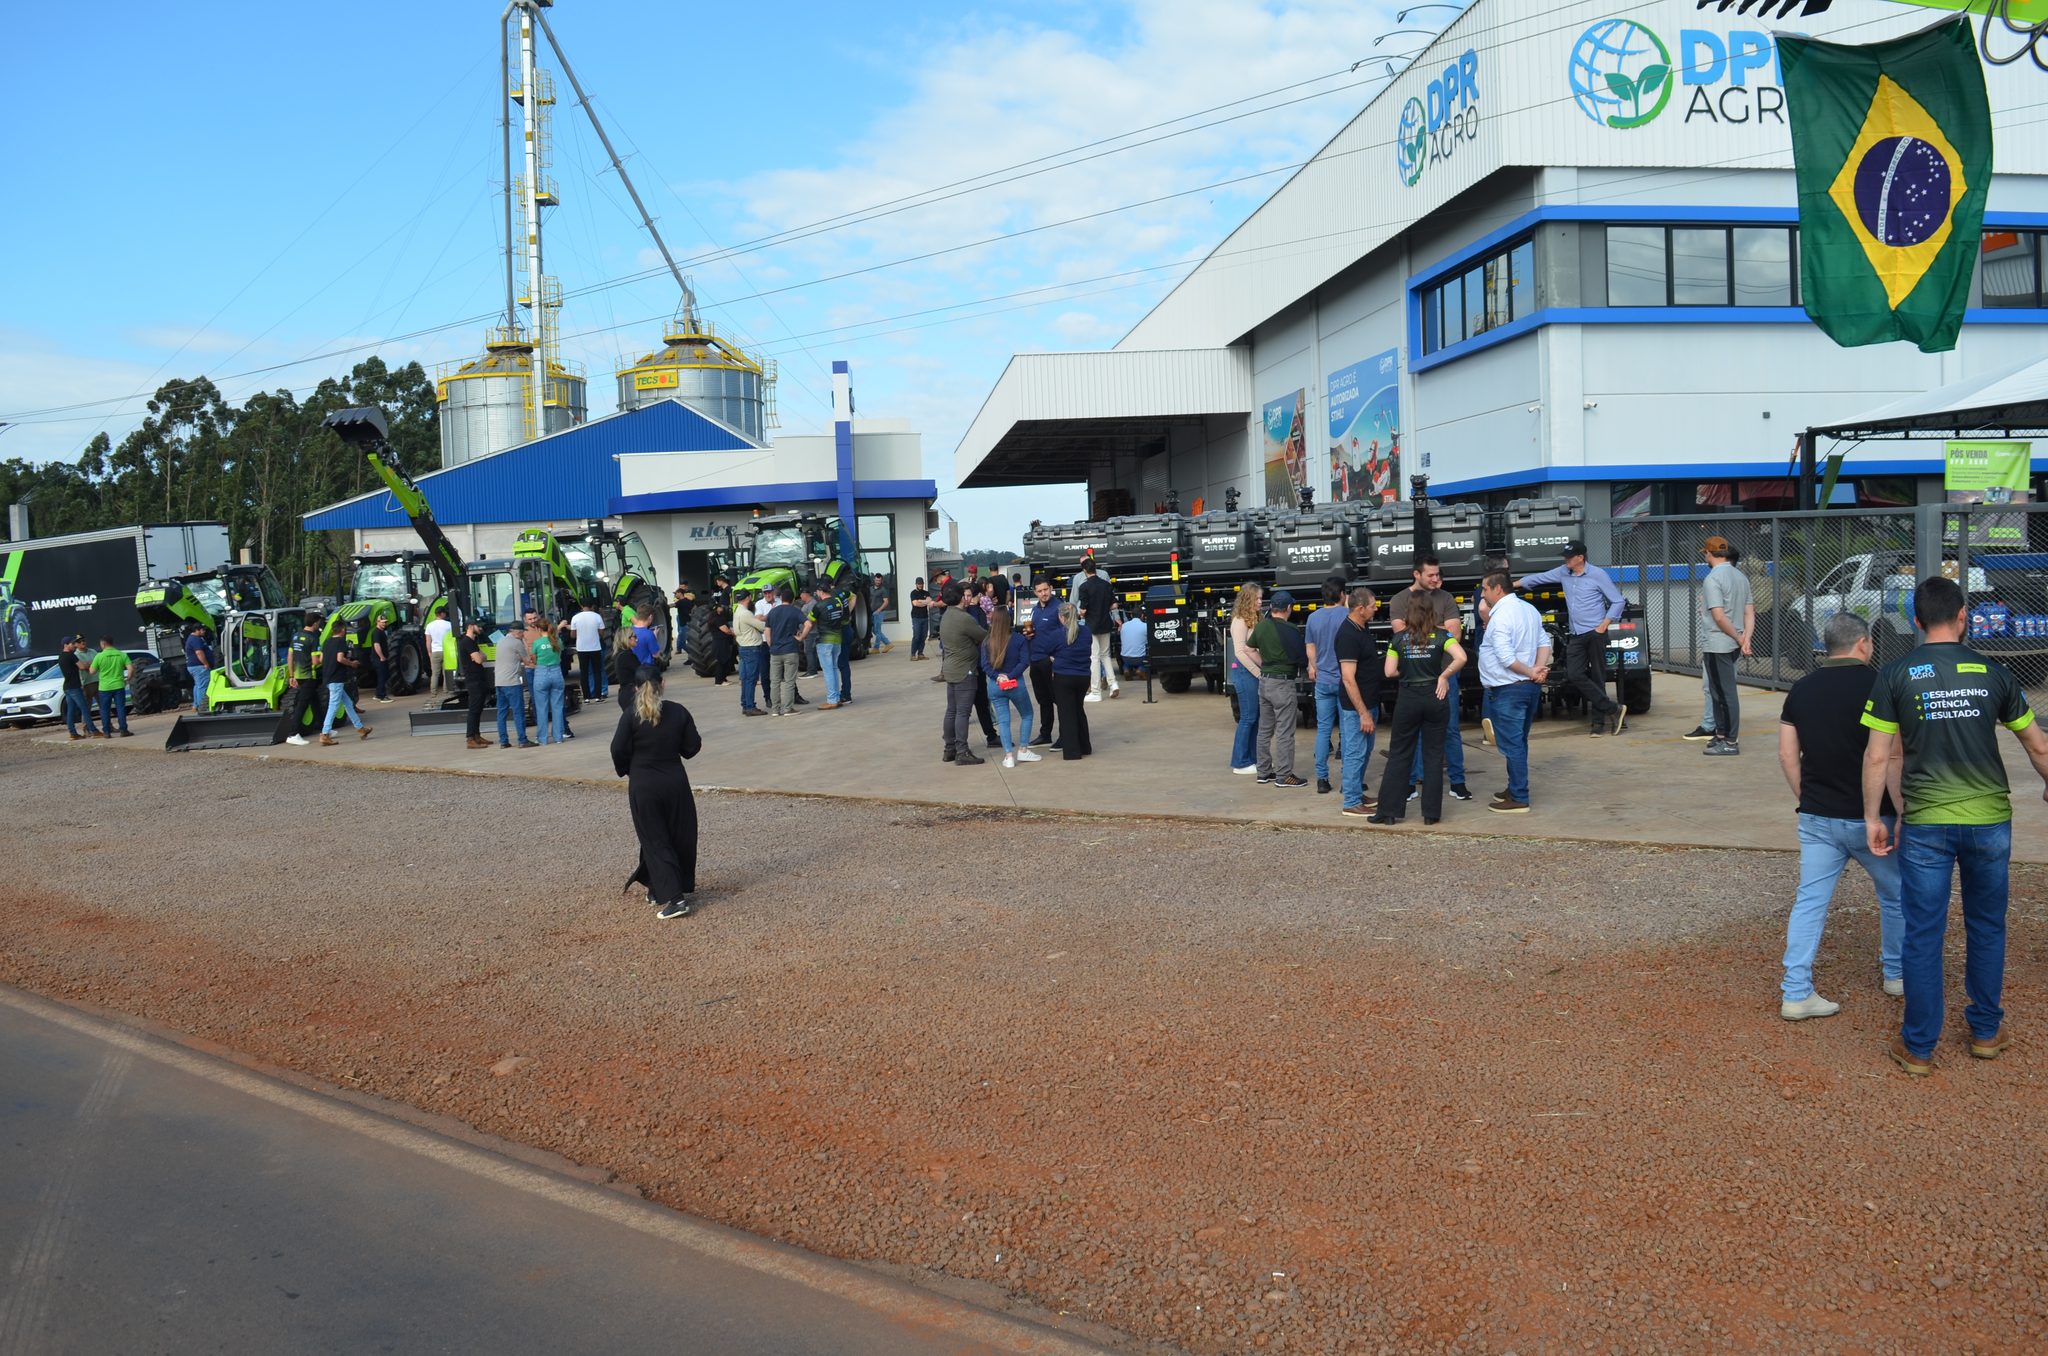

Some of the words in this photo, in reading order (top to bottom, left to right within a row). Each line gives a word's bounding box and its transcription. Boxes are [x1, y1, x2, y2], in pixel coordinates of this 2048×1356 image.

[1680, 29, 1785, 87] DP
[1427, 48, 1479, 135] DPR
[1684, 86, 1785, 124] AGR
[1429, 105, 1478, 170] AGRO
[1950, 448, 1964, 458] PÓS
[1966, 450, 1988, 458] VENDA
[1201, 536, 1238, 545] PLANTIO
[1392, 543, 1415, 553] HID
[1437, 540, 1475, 550] PLUS
[1540, 536, 1569, 545] 4000
[1204, 544, 1236, 552] DIRETO
[1287, 544, 1332, 555] PLANTIO
[41, 594, 98, 610] MANTOMAC
[1162, 629, 1177, 637] DPR
[1909, 664, 1934, 676] DPR
[1911, 671, 1936, 681] AGRO
[1922, 688, 1989, 700] DESEMPENHO
[1923, 699, 1971, 710] POTÊNCIA
[1925, 709, 1981, 721] RESULTADO
